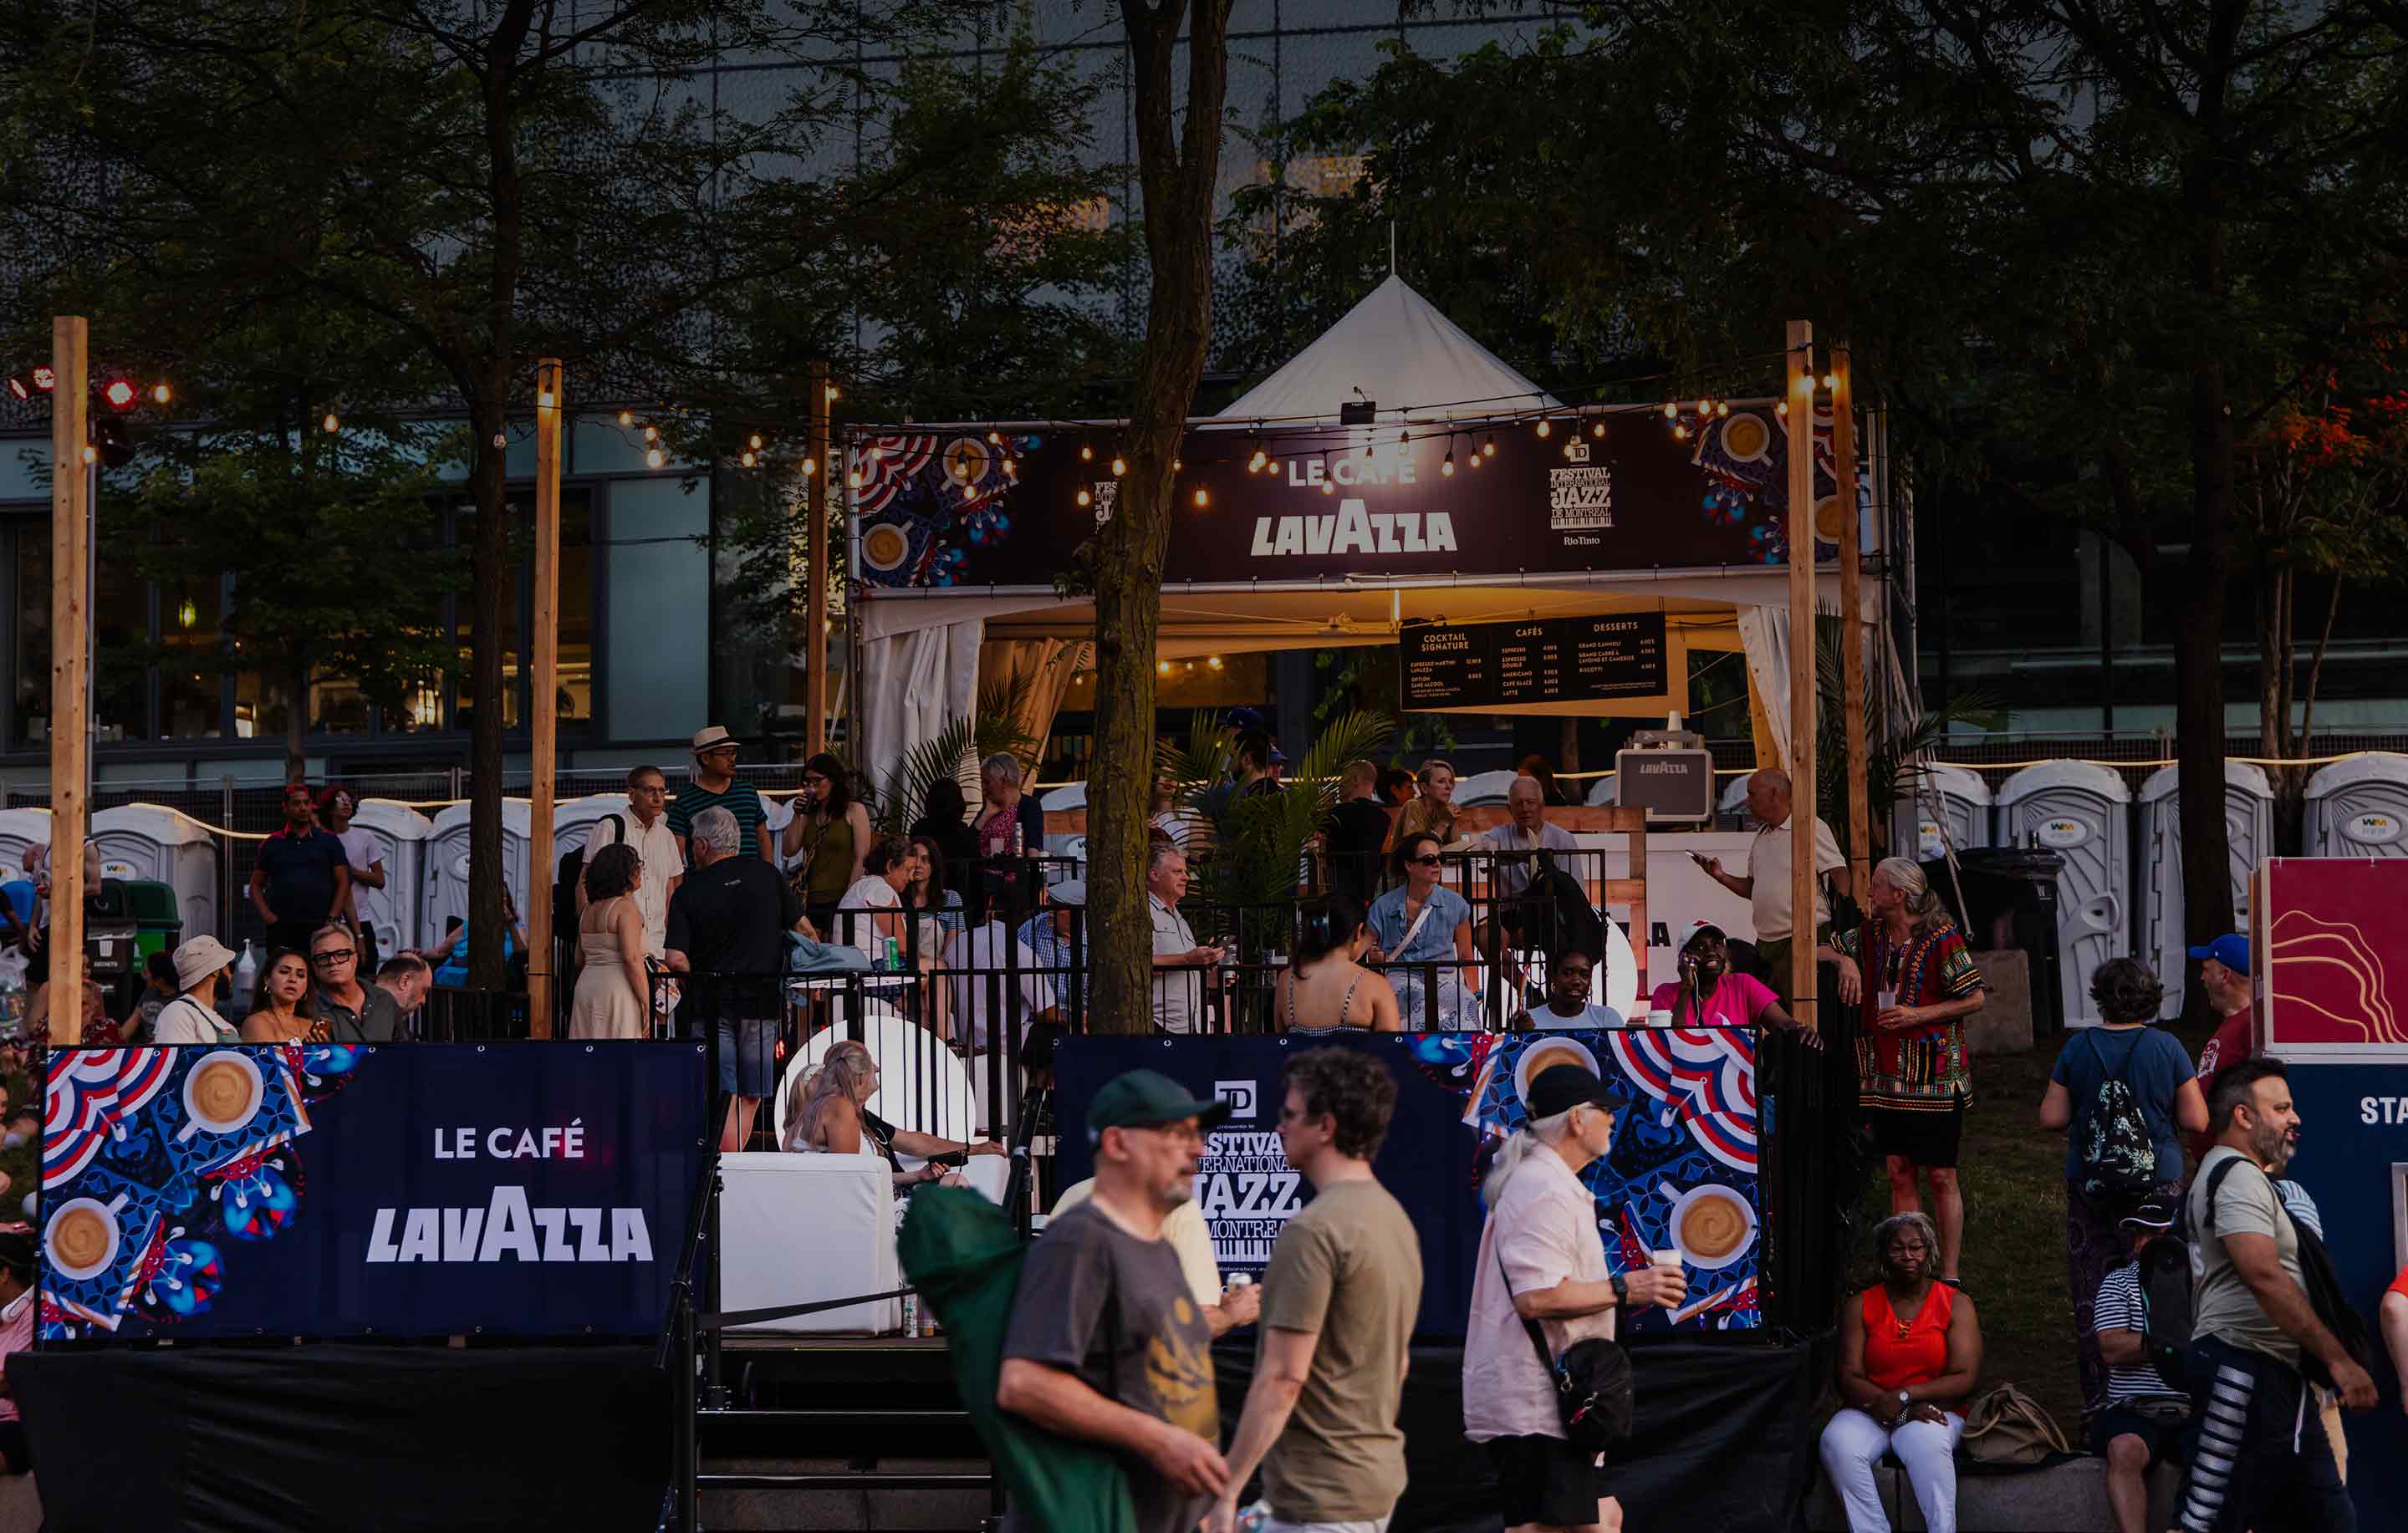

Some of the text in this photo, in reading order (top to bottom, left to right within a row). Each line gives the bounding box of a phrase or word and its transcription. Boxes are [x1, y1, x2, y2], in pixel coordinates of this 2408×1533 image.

[1288, 459, 1325, 487] LE
[1549, 466, 1611, 481] FESTIVAL
[1550, 477, 1612, 488] INTERNATIONAL
[1550, 486, 1612, 509] JAZZ
[1250, 498, 1458, 557] LAVAZZA
[1423, 632, 1467, 643] COCKTAIL
[1515, 625, 1543, 638] CAFÉS
[1593, 622, 1639, 633] DESSERTS
[1421, 641, 1470, 652] SIGNATURE
[1639, 760, 1688, 775] LAVAZZA
[1217, 1087, 1252, 1110] TD
[2360, 1096, 2408, 1124] STA
[434, 1117, 584, 1159] LE CAFÉ
[1204, 1132, 1287, 1157] STIVA
[365, 1184, 655, 1263] LAVAZZA
